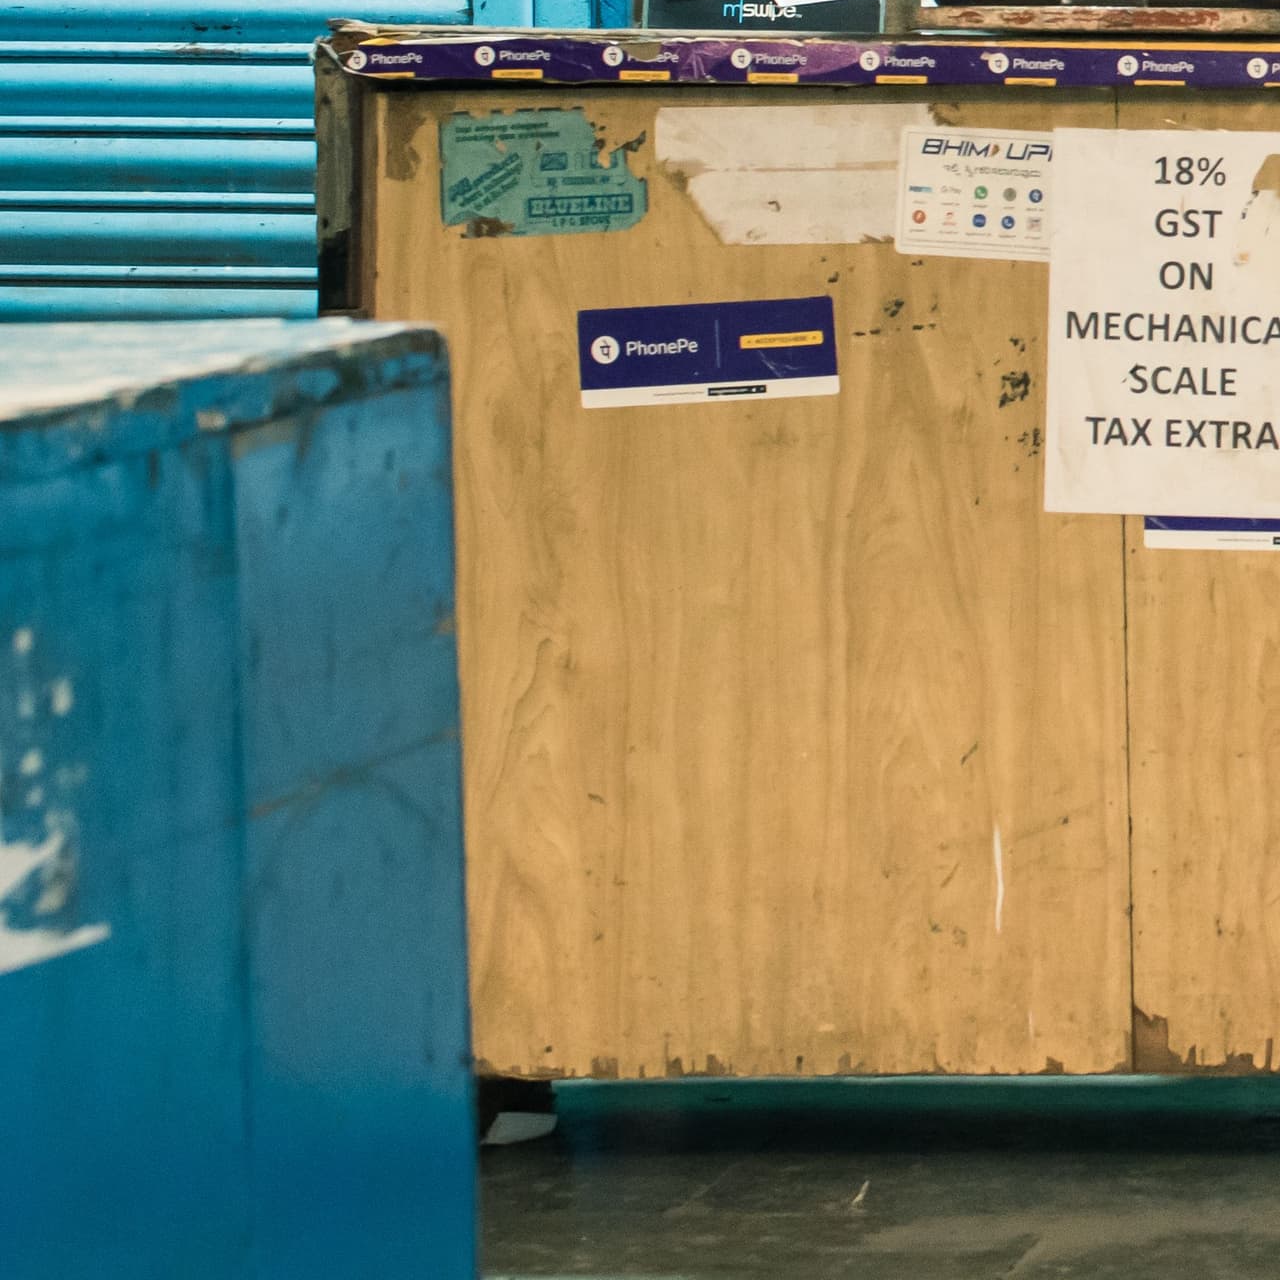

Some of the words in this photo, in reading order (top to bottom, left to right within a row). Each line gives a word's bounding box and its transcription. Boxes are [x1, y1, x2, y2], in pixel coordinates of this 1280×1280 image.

[371, 52, 423, 65] PhonePe
[498, 49, 551, 62] PhonePe
[755, 54, 807, 66] PhonePe
[884, 56, 936, 68] PhonePe
[1012, 58, 1065, 70] PhonePe
[1142, 60, 1195, 73] PhonePe
[922, 138, 991, 158] BHIM
[1154, 156, 1227, 187] 18%
[1154, 208, 1223, 238] GST
[1159, 261, 1214, 290] ON
[625, 338, 699, 357] PhonePe
[1128, 365, 1238, 396] SCALE
[1085, 416, 1152, 447] TAX
[1164, 418, 1280, 450] EXTRA
